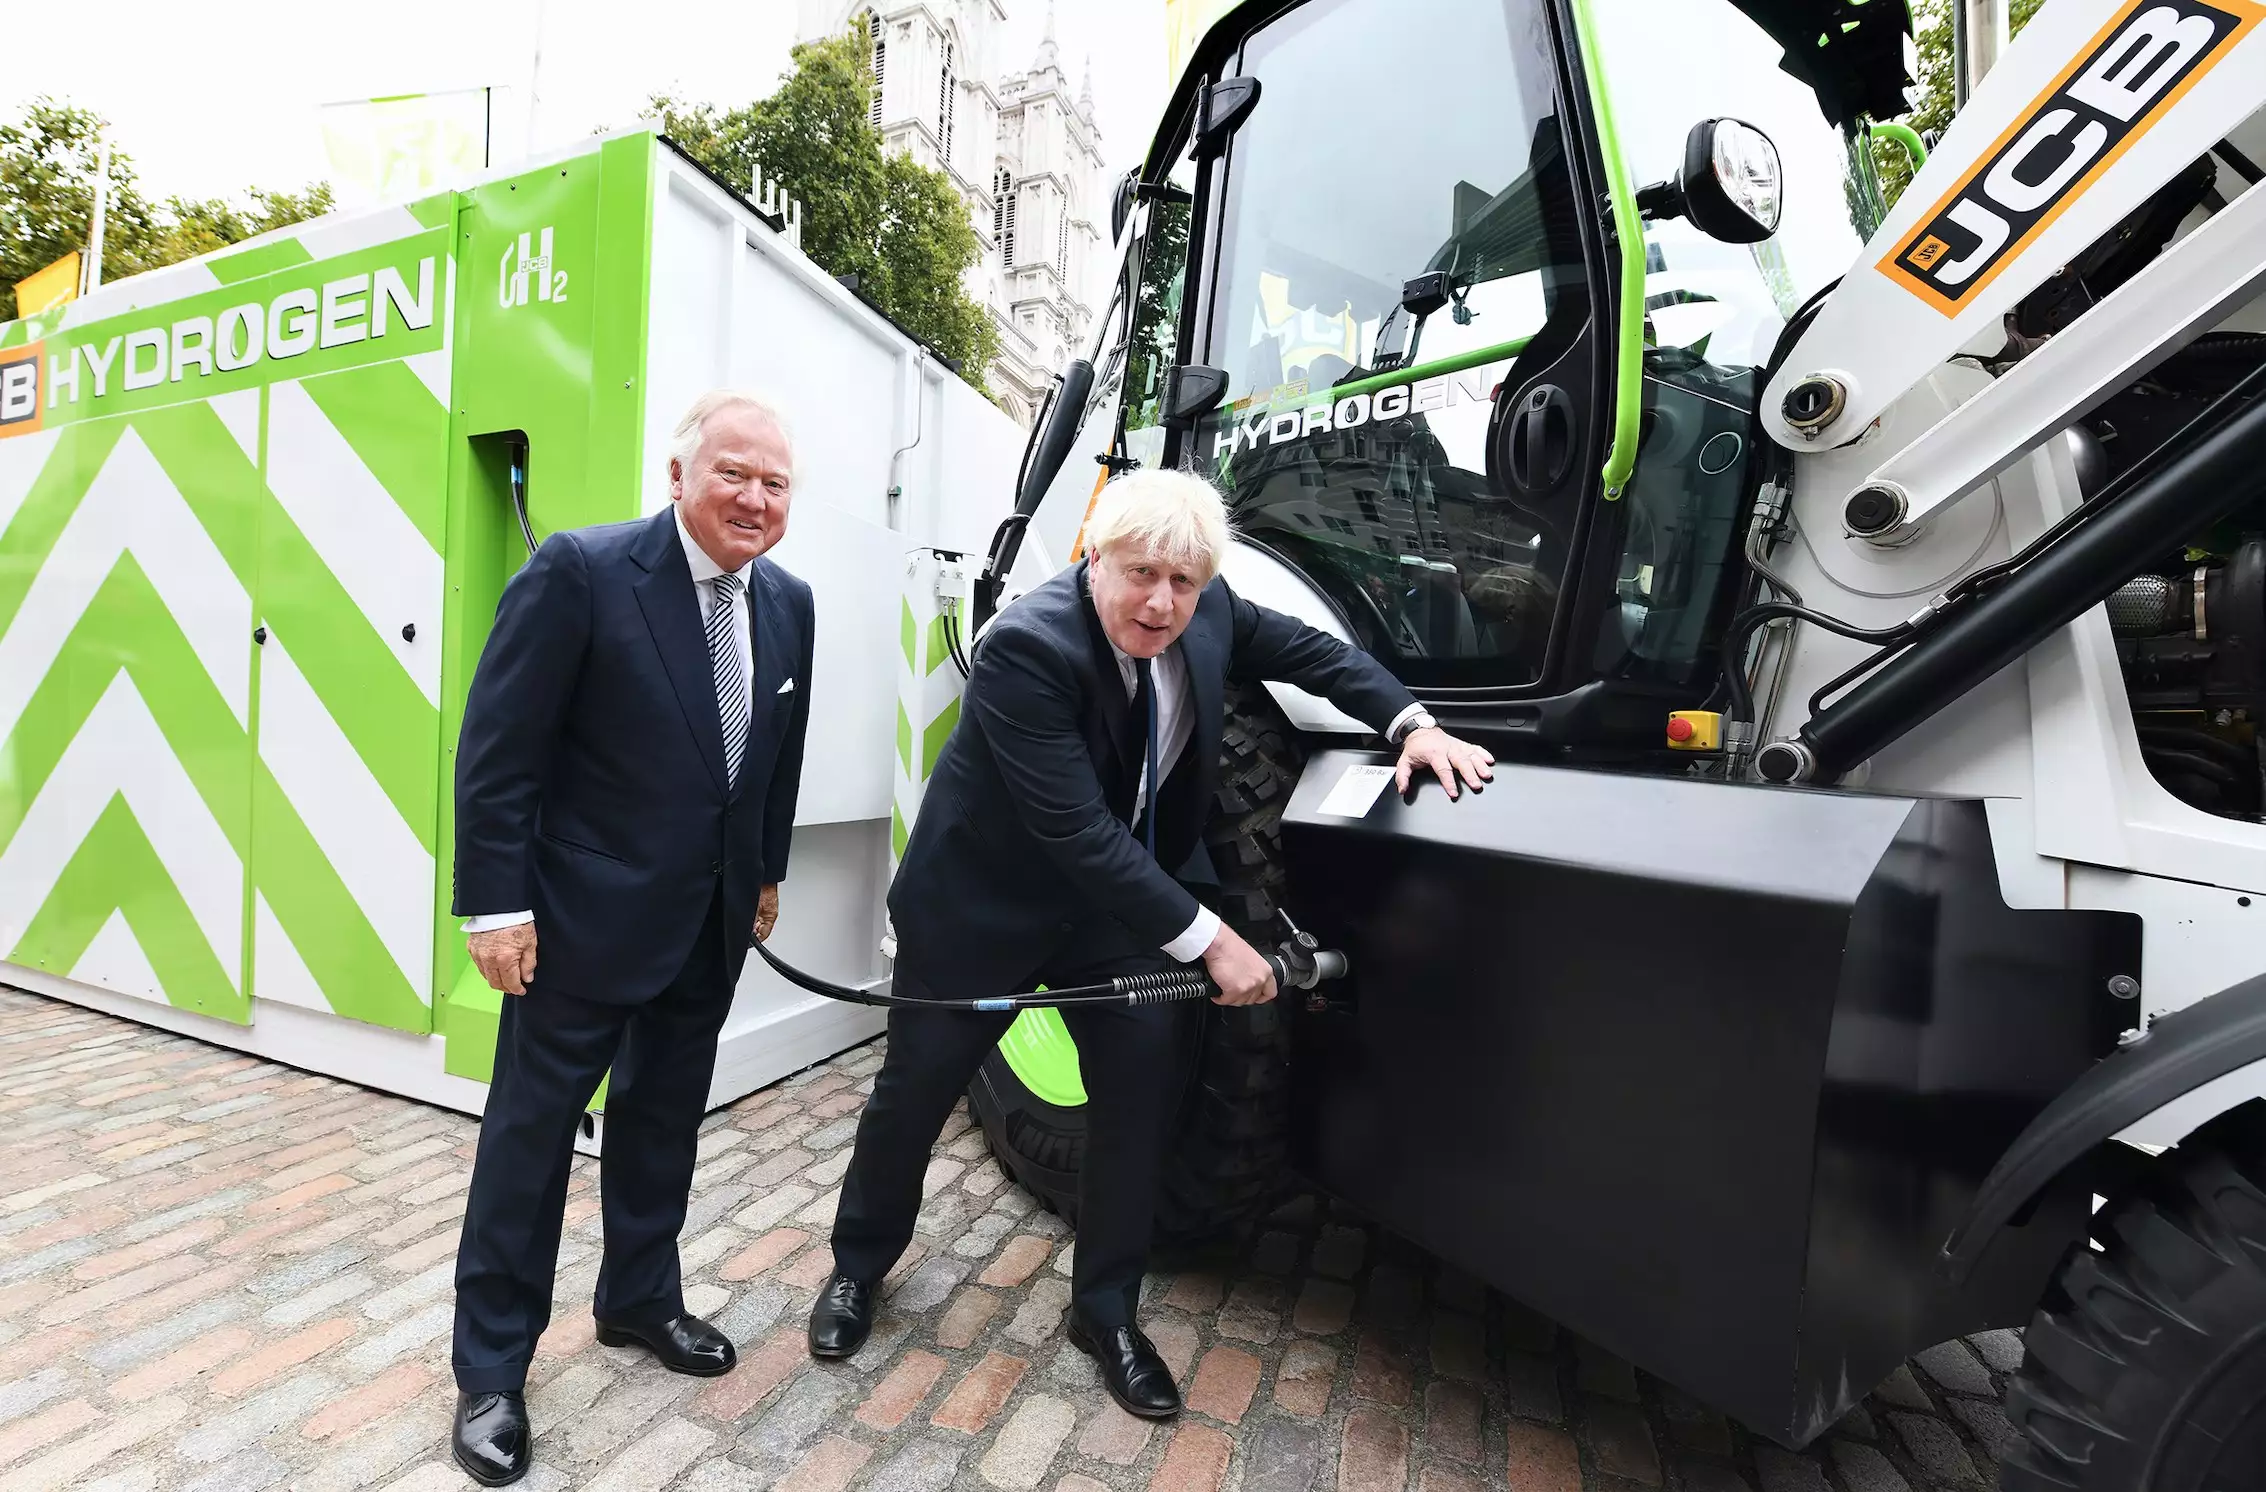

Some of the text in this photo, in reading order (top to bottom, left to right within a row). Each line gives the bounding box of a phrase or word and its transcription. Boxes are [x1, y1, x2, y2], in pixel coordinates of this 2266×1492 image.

[1933, 5, 2216, 285] JCB
[520, 256, 549, 274] JCB
[1917, 243, 1939, 261] JCB
[0, 256, 437, 420] B HYDROGEN
[1212, 366, 1494, 460] HYDROGEN
